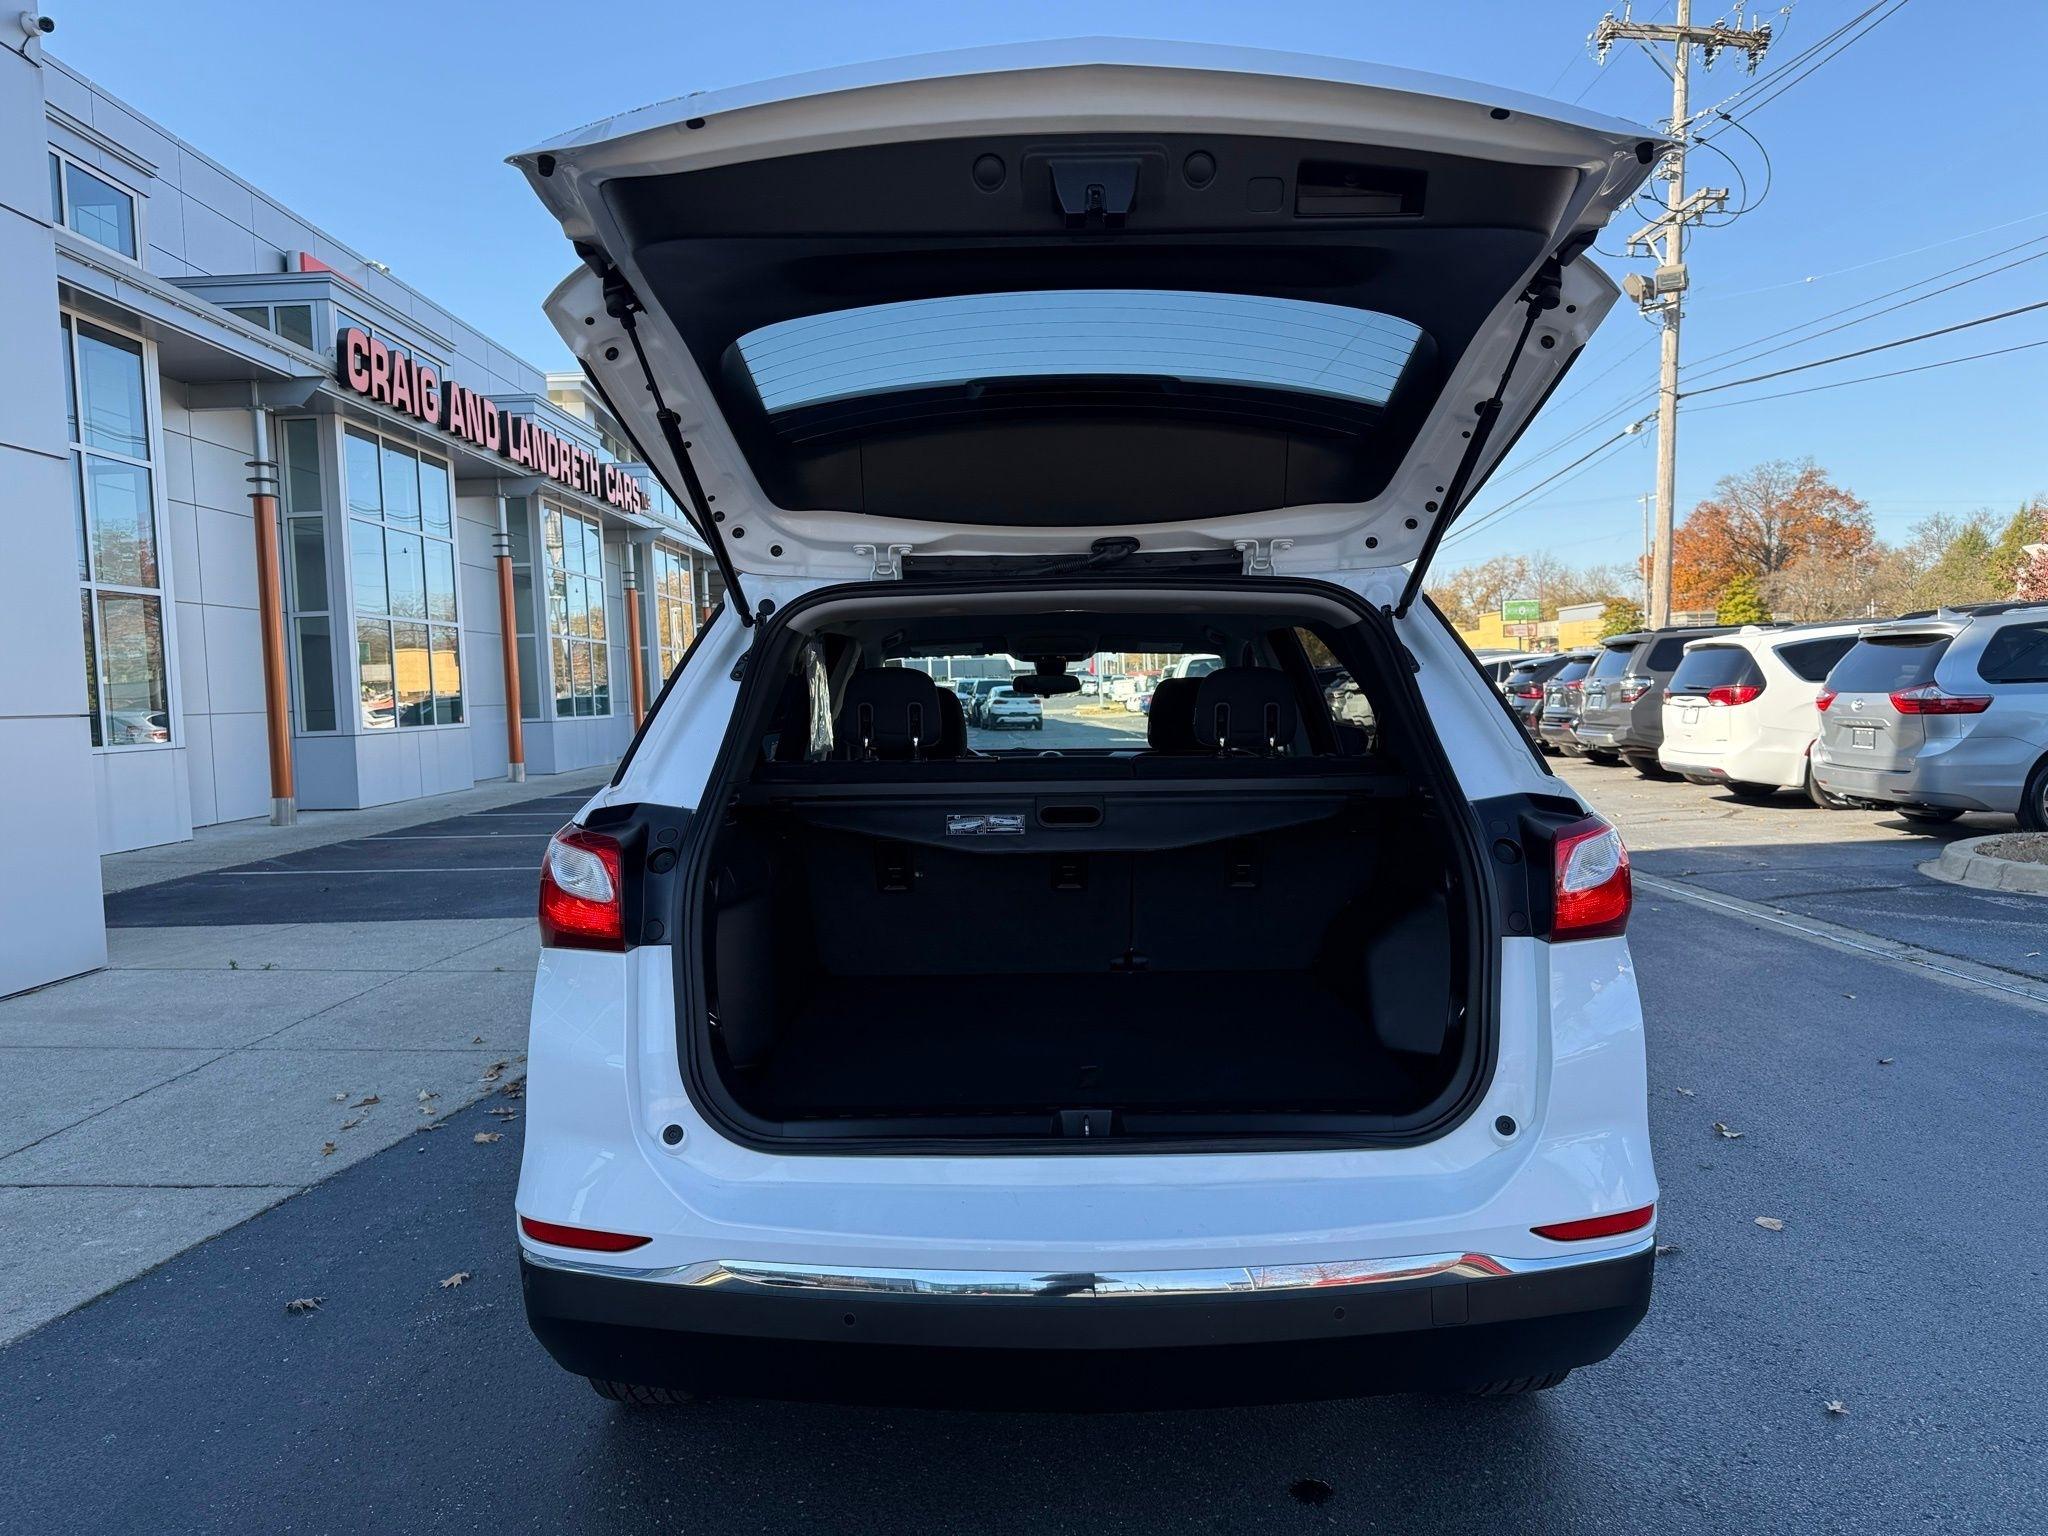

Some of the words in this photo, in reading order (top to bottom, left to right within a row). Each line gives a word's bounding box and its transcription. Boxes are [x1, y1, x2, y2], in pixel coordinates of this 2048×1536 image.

[345, 328, 439, 424] CRAIG
[449, 381, 499, 451] AND
[502, 410, 601, 497] LANDRETH
[604, 463, 641, 515] CARS
